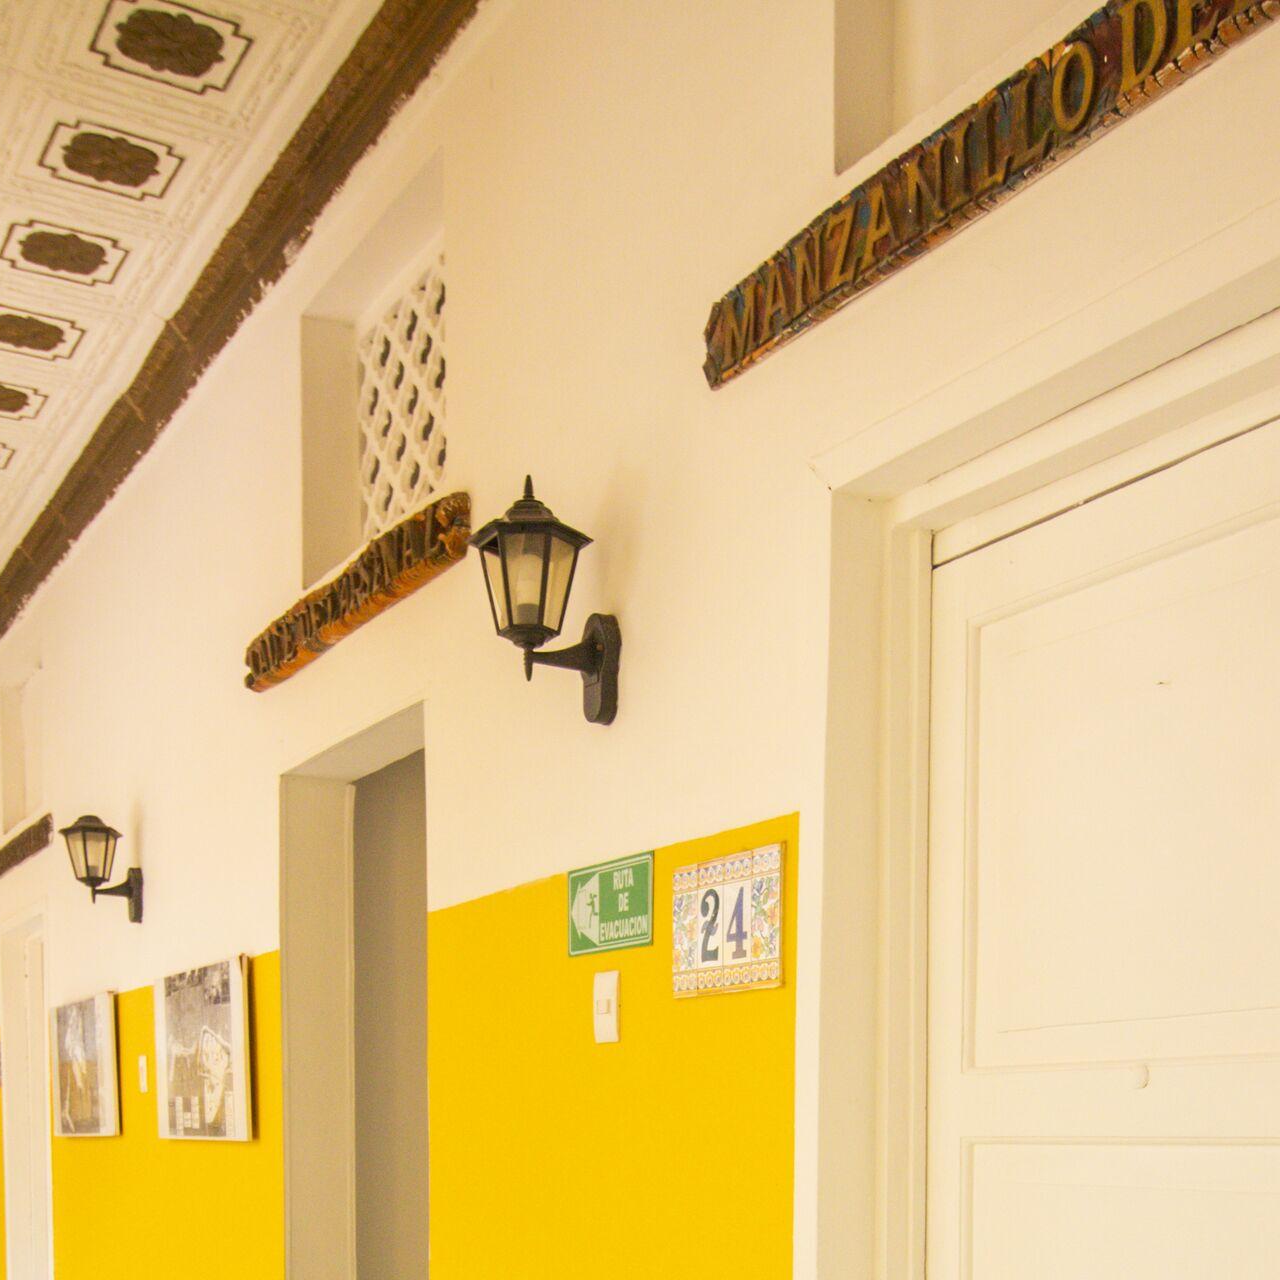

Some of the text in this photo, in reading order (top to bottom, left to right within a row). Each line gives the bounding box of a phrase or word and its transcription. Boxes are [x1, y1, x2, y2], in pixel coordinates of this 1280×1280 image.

[720, 40, 1096, 368] MANZANILLO
[612, 867, 635, 891] RUTA
[618, 893, 630, 912] DE
[700, 886, 748, 963] 24
